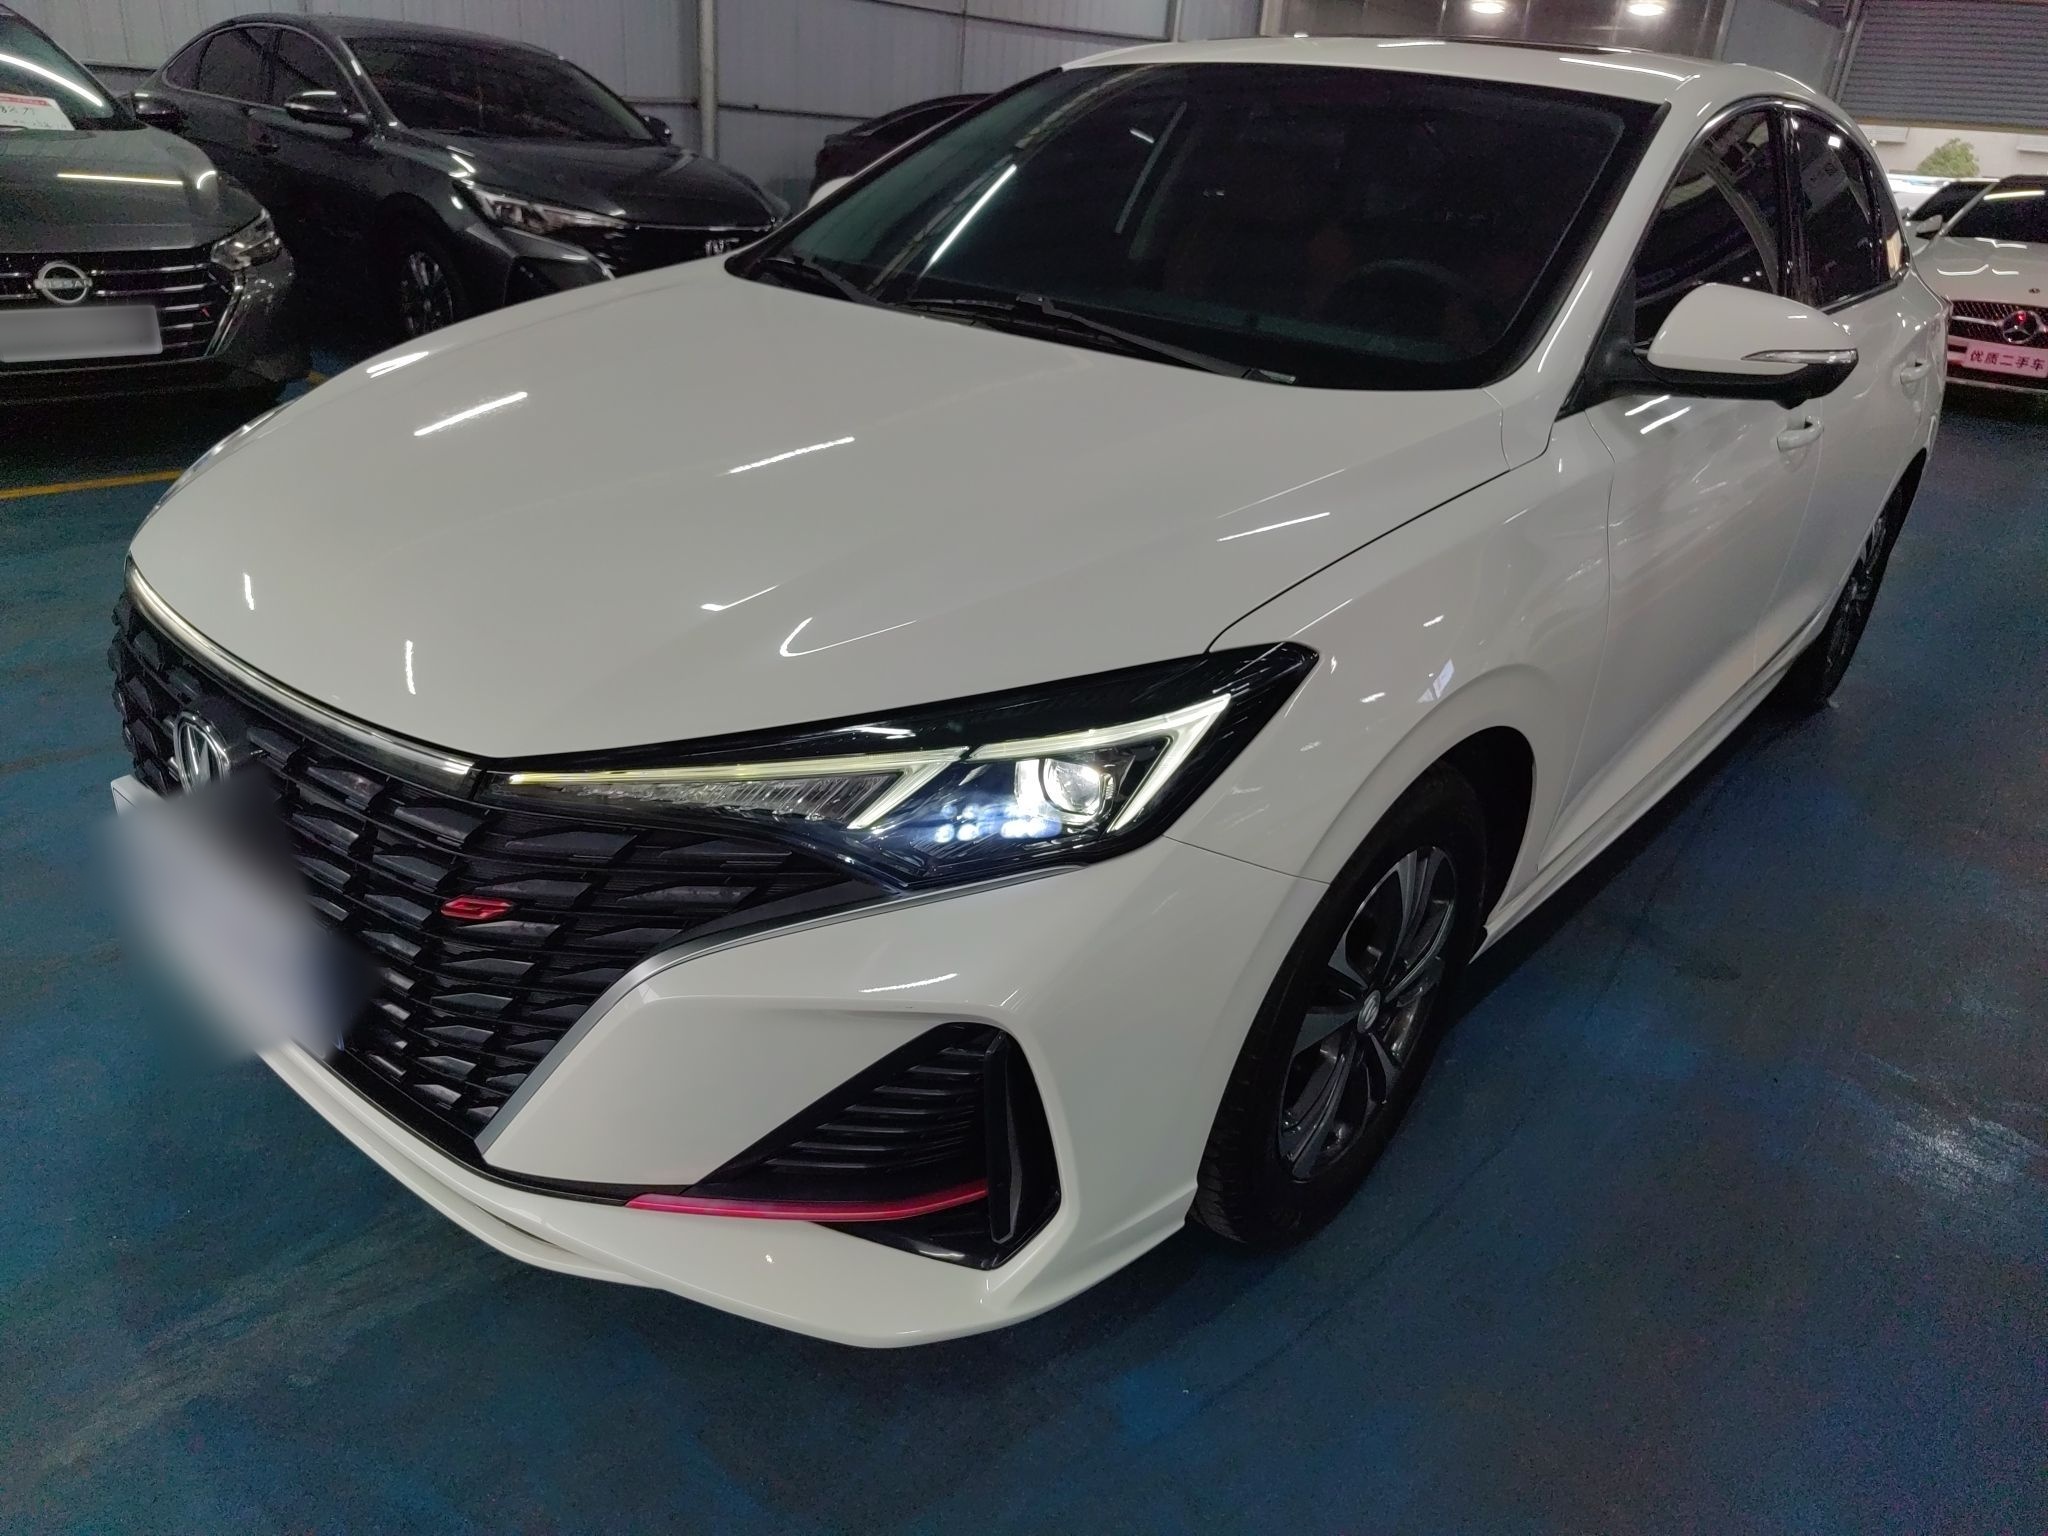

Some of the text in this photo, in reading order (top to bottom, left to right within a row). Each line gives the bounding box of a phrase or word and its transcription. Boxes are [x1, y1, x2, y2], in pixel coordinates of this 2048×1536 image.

[1969, 350, 2045, 371] 优质二手车
